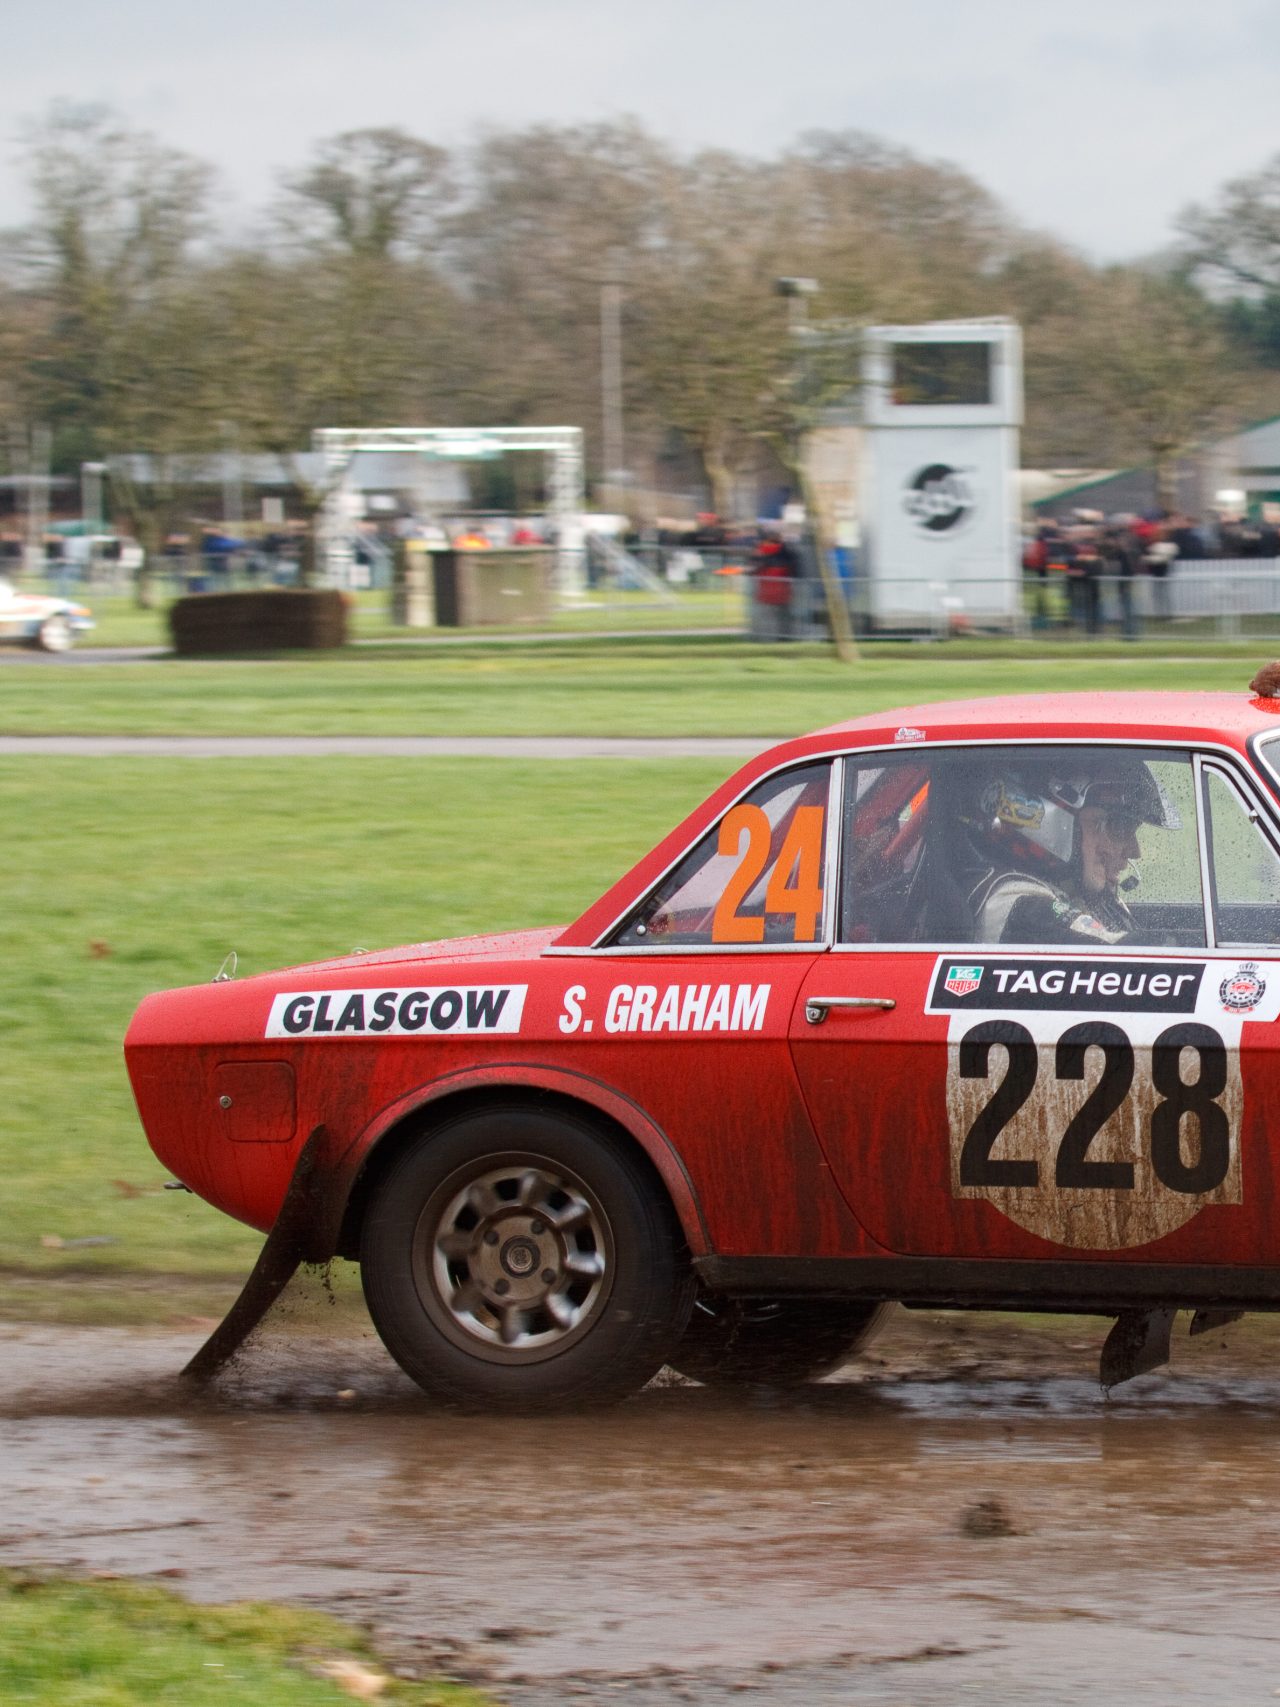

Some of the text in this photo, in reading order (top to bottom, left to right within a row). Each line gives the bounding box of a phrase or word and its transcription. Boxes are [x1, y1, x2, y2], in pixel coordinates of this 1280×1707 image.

[712, 803, 824, 943] 24
[282, 989, 510, 1034] GLASGOW
[558, 983, 772, 1034] S. GRAHAM
[958, 1018, 1231, 1195] 228
